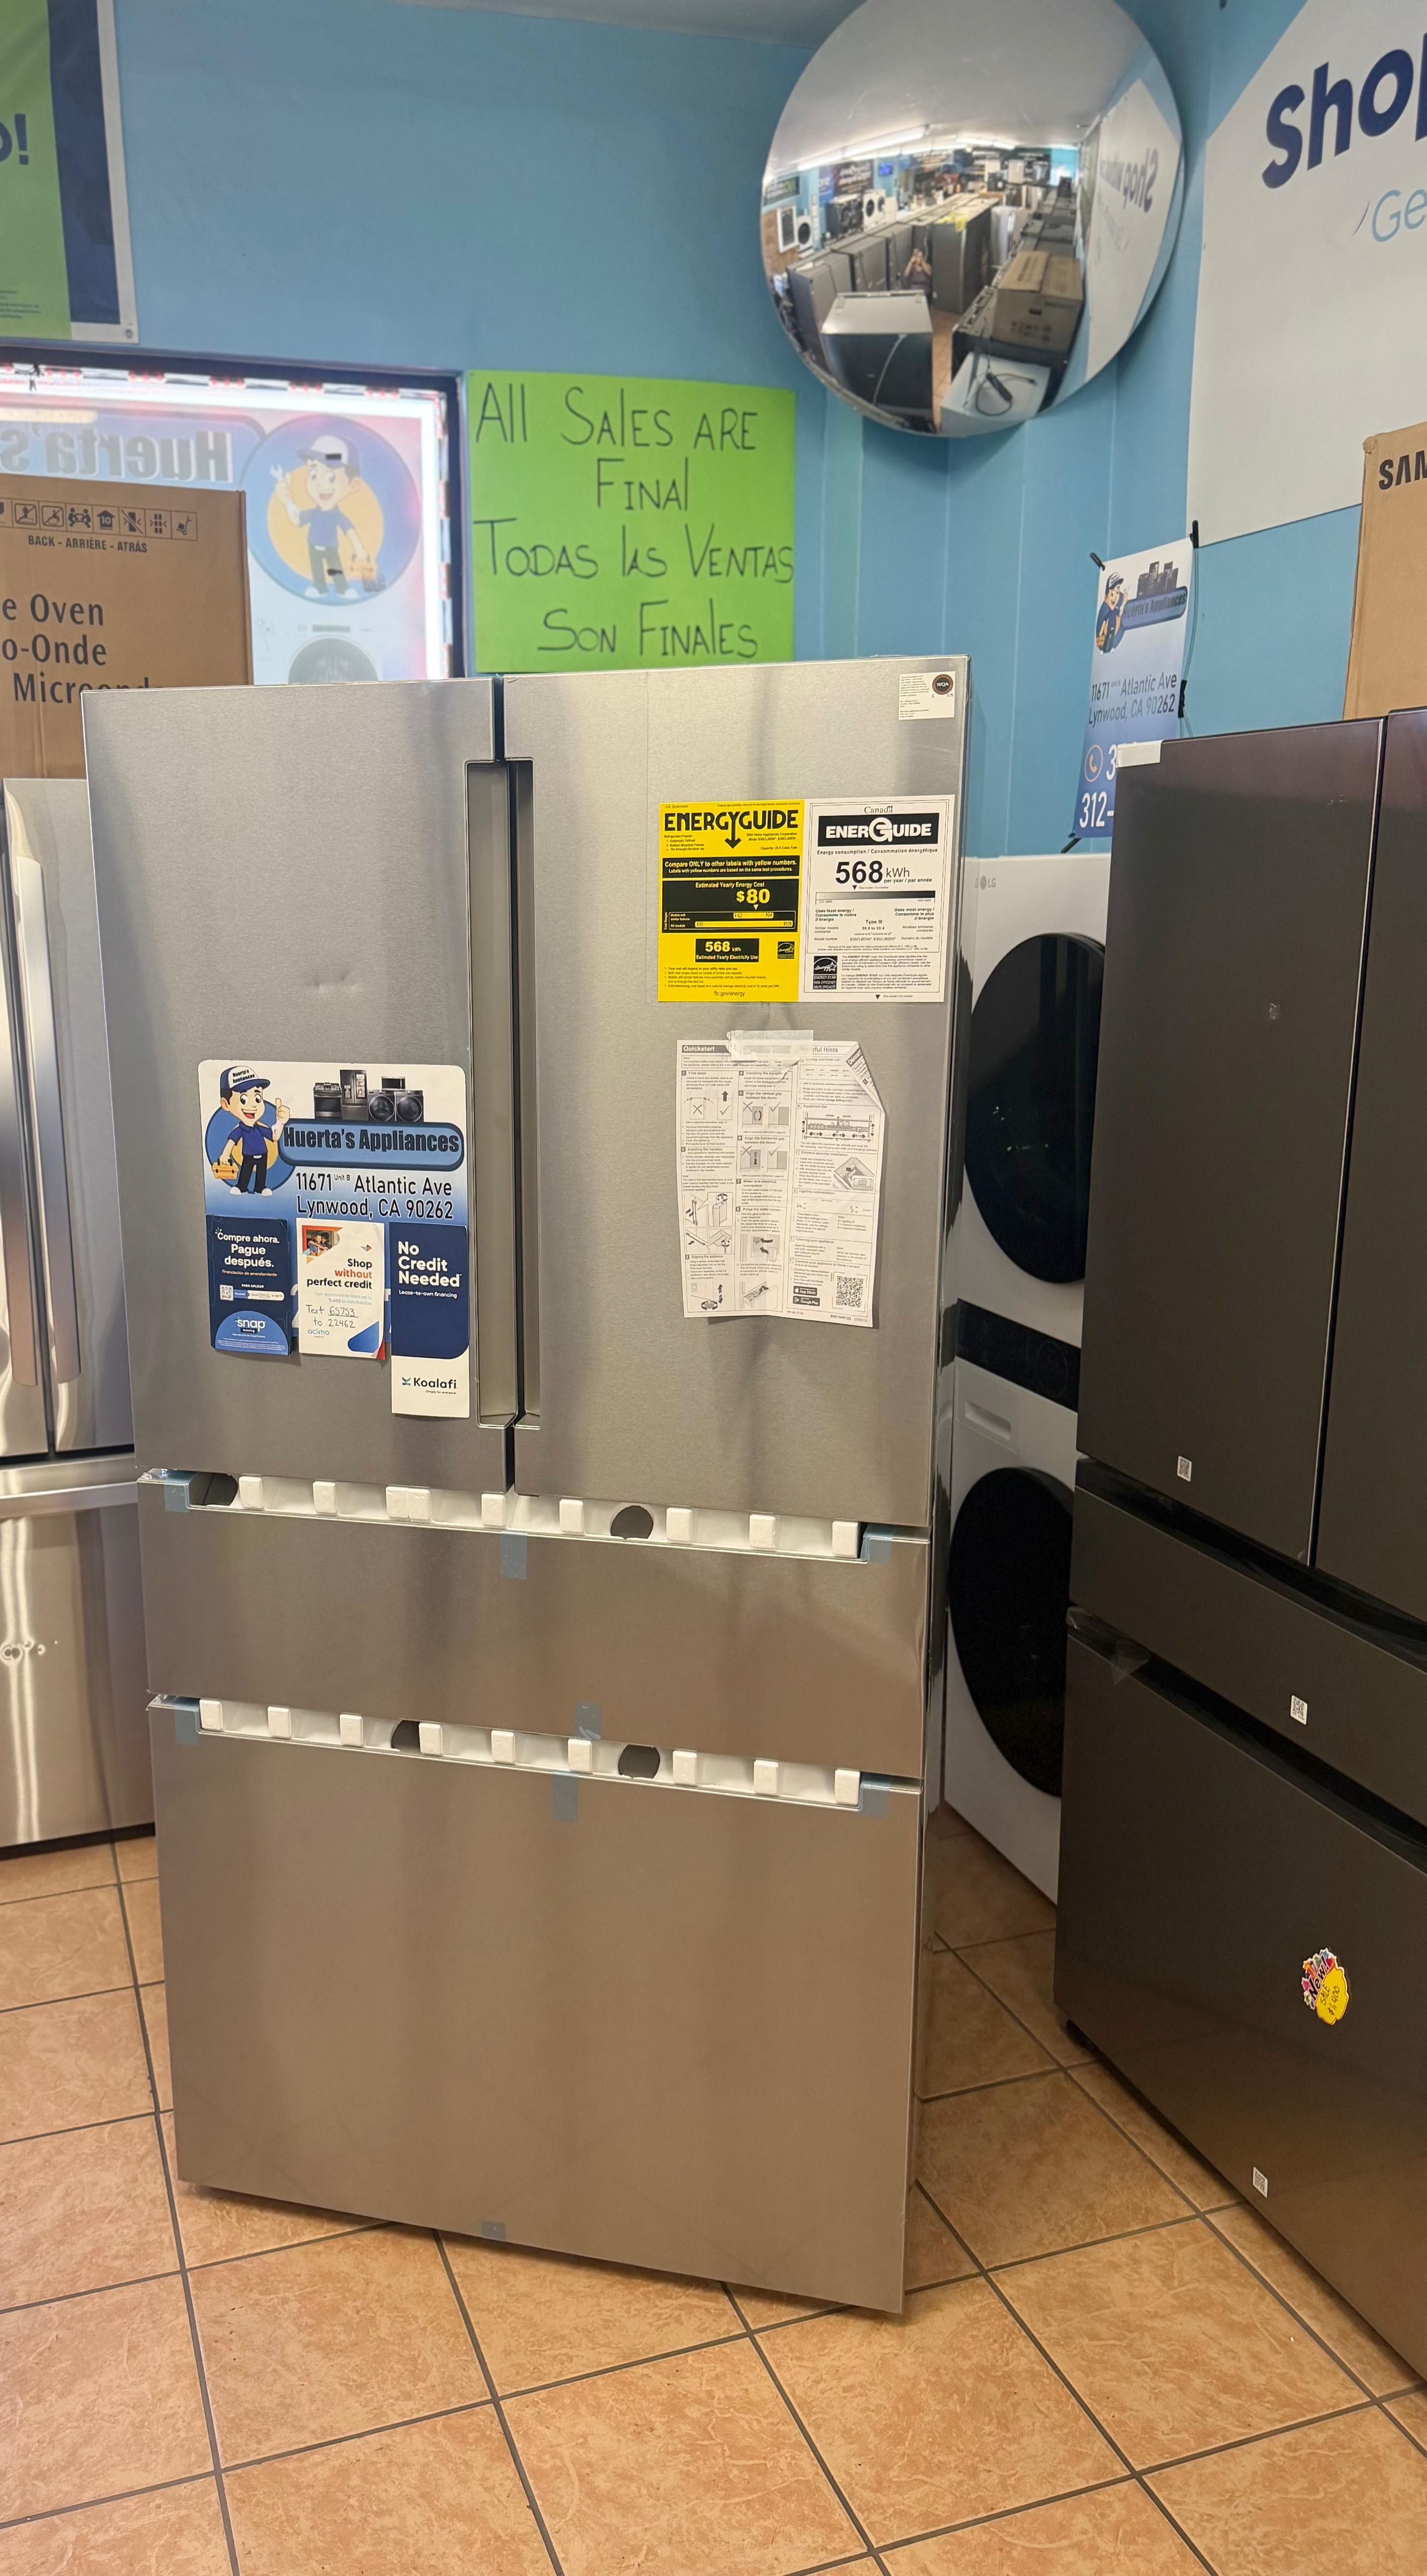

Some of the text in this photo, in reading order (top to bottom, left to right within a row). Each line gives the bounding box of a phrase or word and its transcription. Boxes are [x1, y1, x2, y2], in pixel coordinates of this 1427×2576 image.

[1262, 32, 1427, 189] Sho
[693, 408, 758, 451] ARE
[28, 535, 147, 553] BACK ARRIÈRE ATRÁS
[473, 518, 598, 579] TODAS
[685, 523, 794, 584] VENTAS
[30, 593, 104, 626] Oven
[537, 608, 616, 653] SON
[1091, 672, 1177, 702] 11671 Atlantic Ave
[1088, 693, 1175, 729] Lynwood, CA 90262
[665, 809, 799, 832] ENERGYGUIDE
[826, 817, 931, 843] ENERGUIDE
[835, 860, 910, 884] 568 kWh
[988, 878, 996, 888] LG
[736, 889, 770, 904] $80
[705, 941, 730, 952] 568
[283, 1126, 459, 1153] Huerta's Appliances
[295, 1172, 332, 1191] 11671
[354, 1175, 416, 1195] Atlantic
[422, 1180, 452, 1196] Ave
[297, 1196, 454, 1220] Lynwood, CA 90262
[217, 1232, 280, 1244] Compre ahora.
[231, 1244, 266, 1257] Pague
[398, 1240, 420, 1255] No
[224, 1256, 275, 1269] después.
[348, 1258, 372, 1270] Shop
[398, 1256, 448, 1272] Credit
[334, 1268, 372, 1279] without
[399, 1270, 460, 1287] Needed
[306, 1277, 372, 1290] perfect credit
[305, 1304, 355, 1317] Text 65753
[237, 1319, 266, 1332] snap
[313, 1317, 356, 1328] to 22462
[414, 1377, 457, 1389] Koalafi
